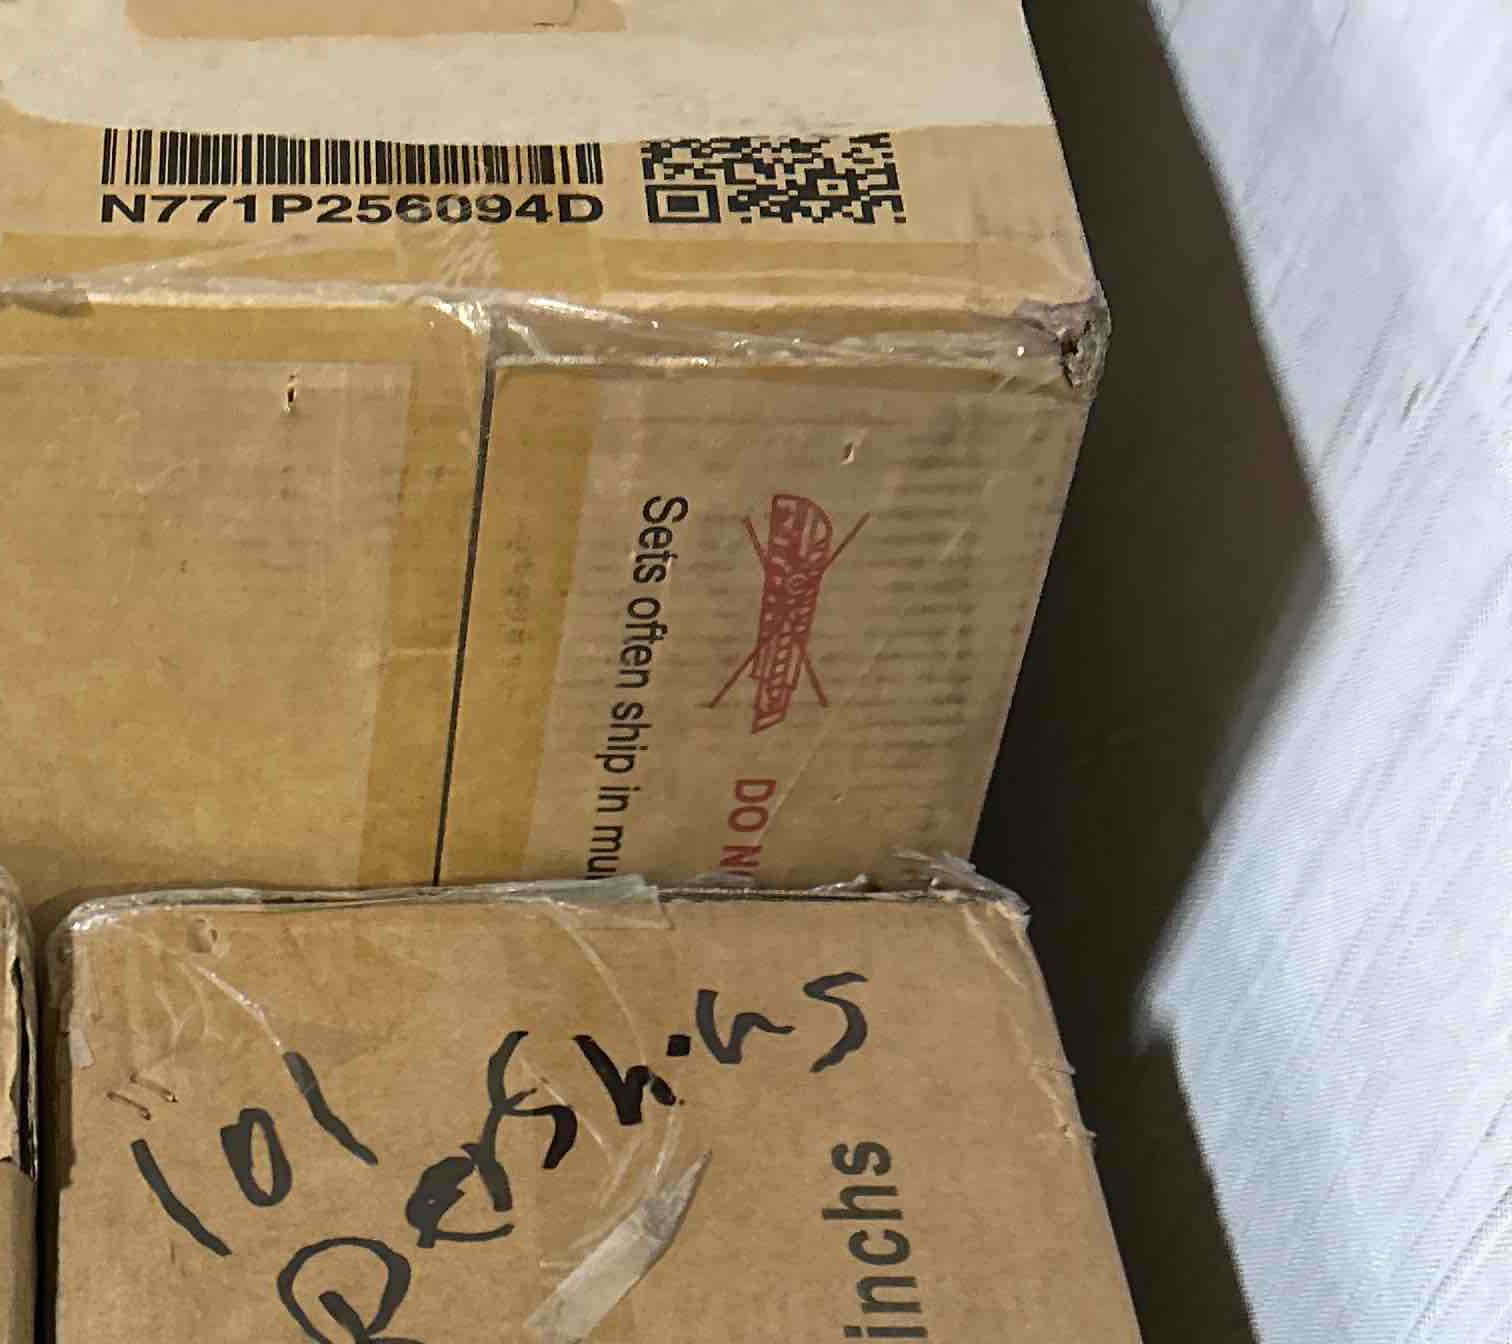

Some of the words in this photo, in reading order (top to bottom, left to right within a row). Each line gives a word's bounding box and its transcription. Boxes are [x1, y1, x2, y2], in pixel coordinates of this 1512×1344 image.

[100, 193, 605, 225] N771P256094D
[632, 495, 689, 584] Sets
[615, 596, 669, 690] often
[594, 701, 653, 774] ship
[596, 784, 642, 814] in
[727, 778, 777, 833] DO
[586, 824, 624, 881] mu
[718, 844, 764, 880] N
